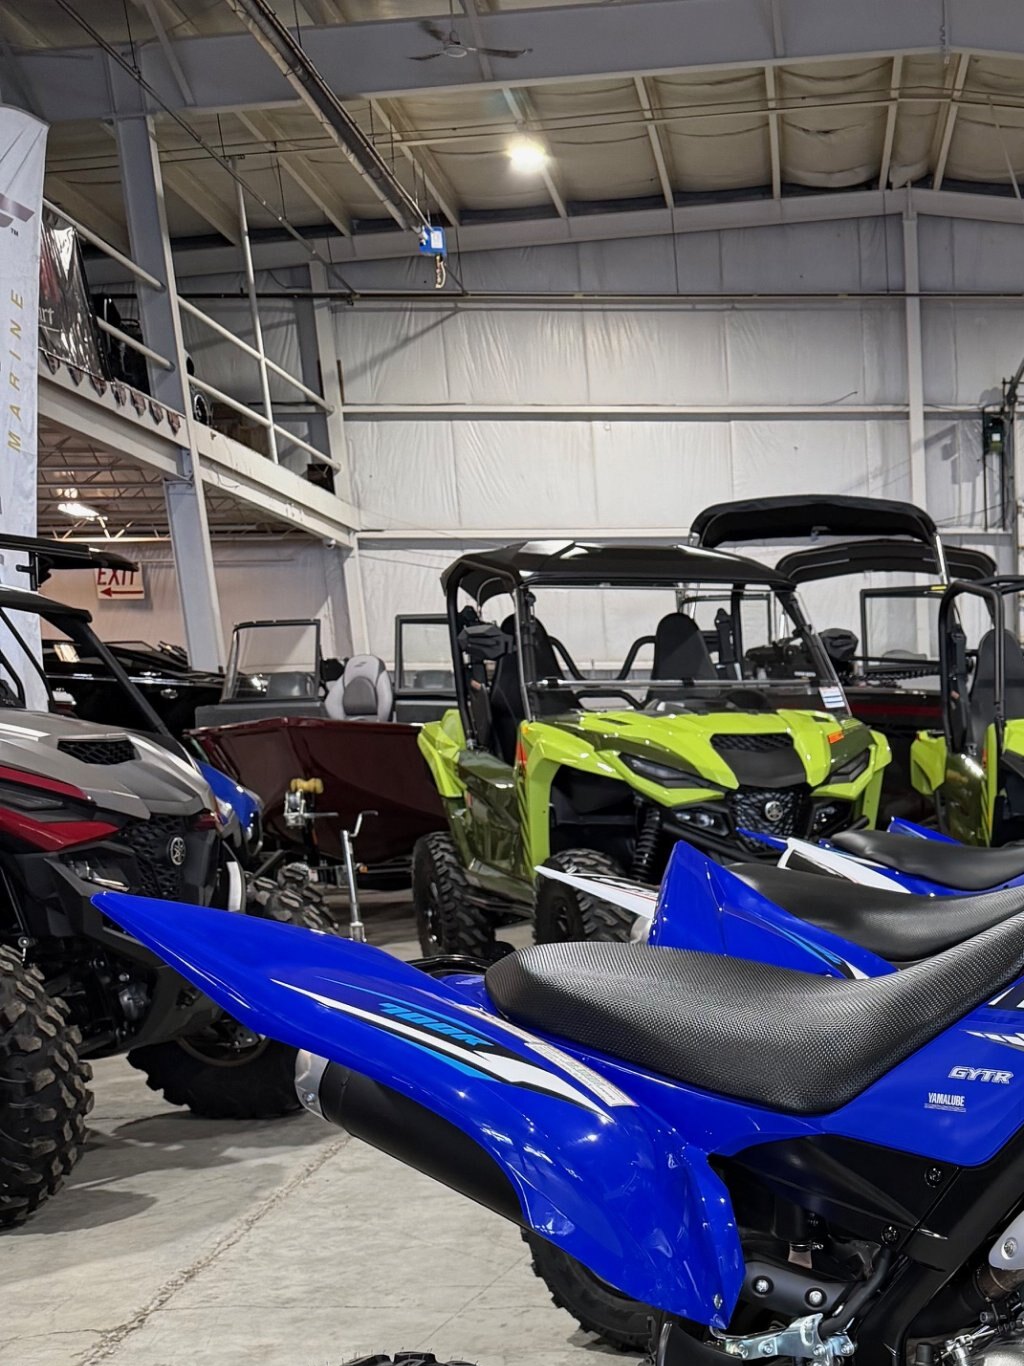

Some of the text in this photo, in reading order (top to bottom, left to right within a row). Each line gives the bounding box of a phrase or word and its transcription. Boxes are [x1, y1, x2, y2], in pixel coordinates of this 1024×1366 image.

[8, 289, 24, 453] MARINE
[948, 1066, 1014, 1085] GYTR
[928, 1092, 965, 1107] YAMALUBE
